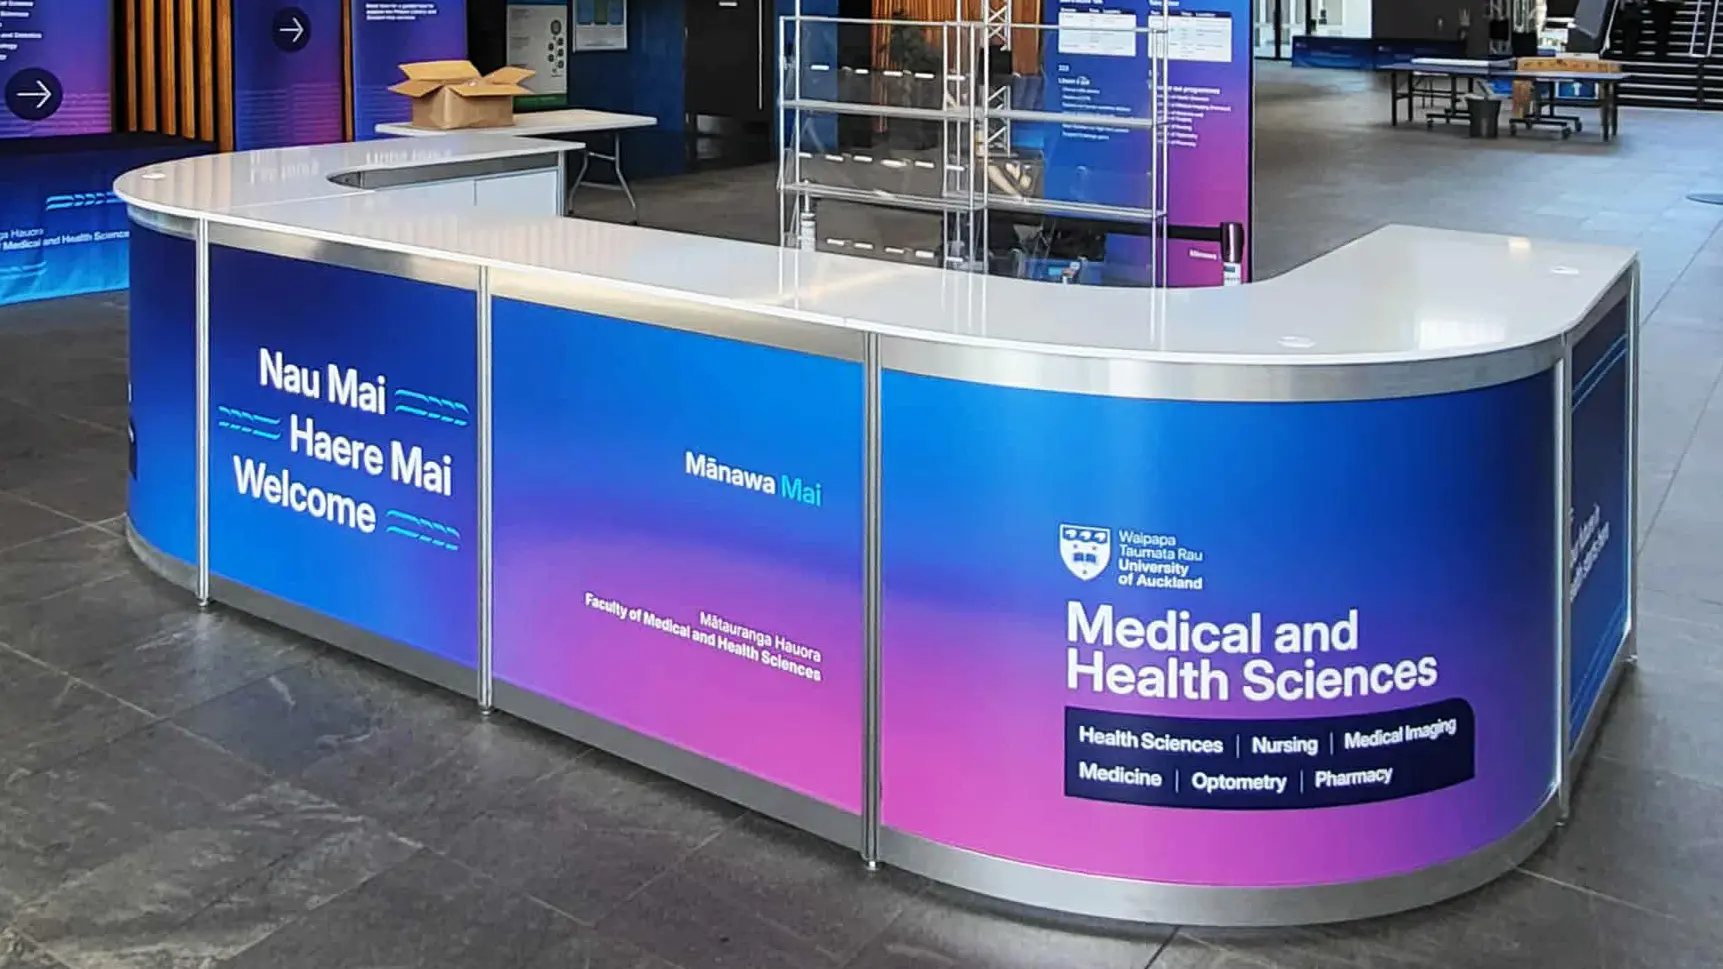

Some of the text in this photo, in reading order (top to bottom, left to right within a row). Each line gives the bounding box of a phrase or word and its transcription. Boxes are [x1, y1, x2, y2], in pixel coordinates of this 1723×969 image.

[3, 239, 41, 250] Medical
[42, 236, 60, 246] and
[61, 233, 93, 244] Health
[259, 347, 386, 415] Nau Mai
[290, 413, 452, 496] Haere Mai
[233, 454, 376, 533] Welcome
[685, 450, 822, 506] Mānawa Mai
[1118, 530, 1177, 548] Waipapa
[1119, 544, 1203, 562] Taumata Rau
[1118, 558, 1190, 577] University
[1118, 573, 1203, 590] of Auckland
[584, 591, 822, 682] Faculty of Medical and Health Sciences
[1067, 600, 1358, 655] Medical and
[775, 635, 822, 663] Hauora
[1067, 647, 1438, 701] Health Sciences
[1078, 717, 1458, 756] Health Sciences Nursing Medical Imaging
[1078, 761, 1394, 794] Medicine Optometry Pharmacy
